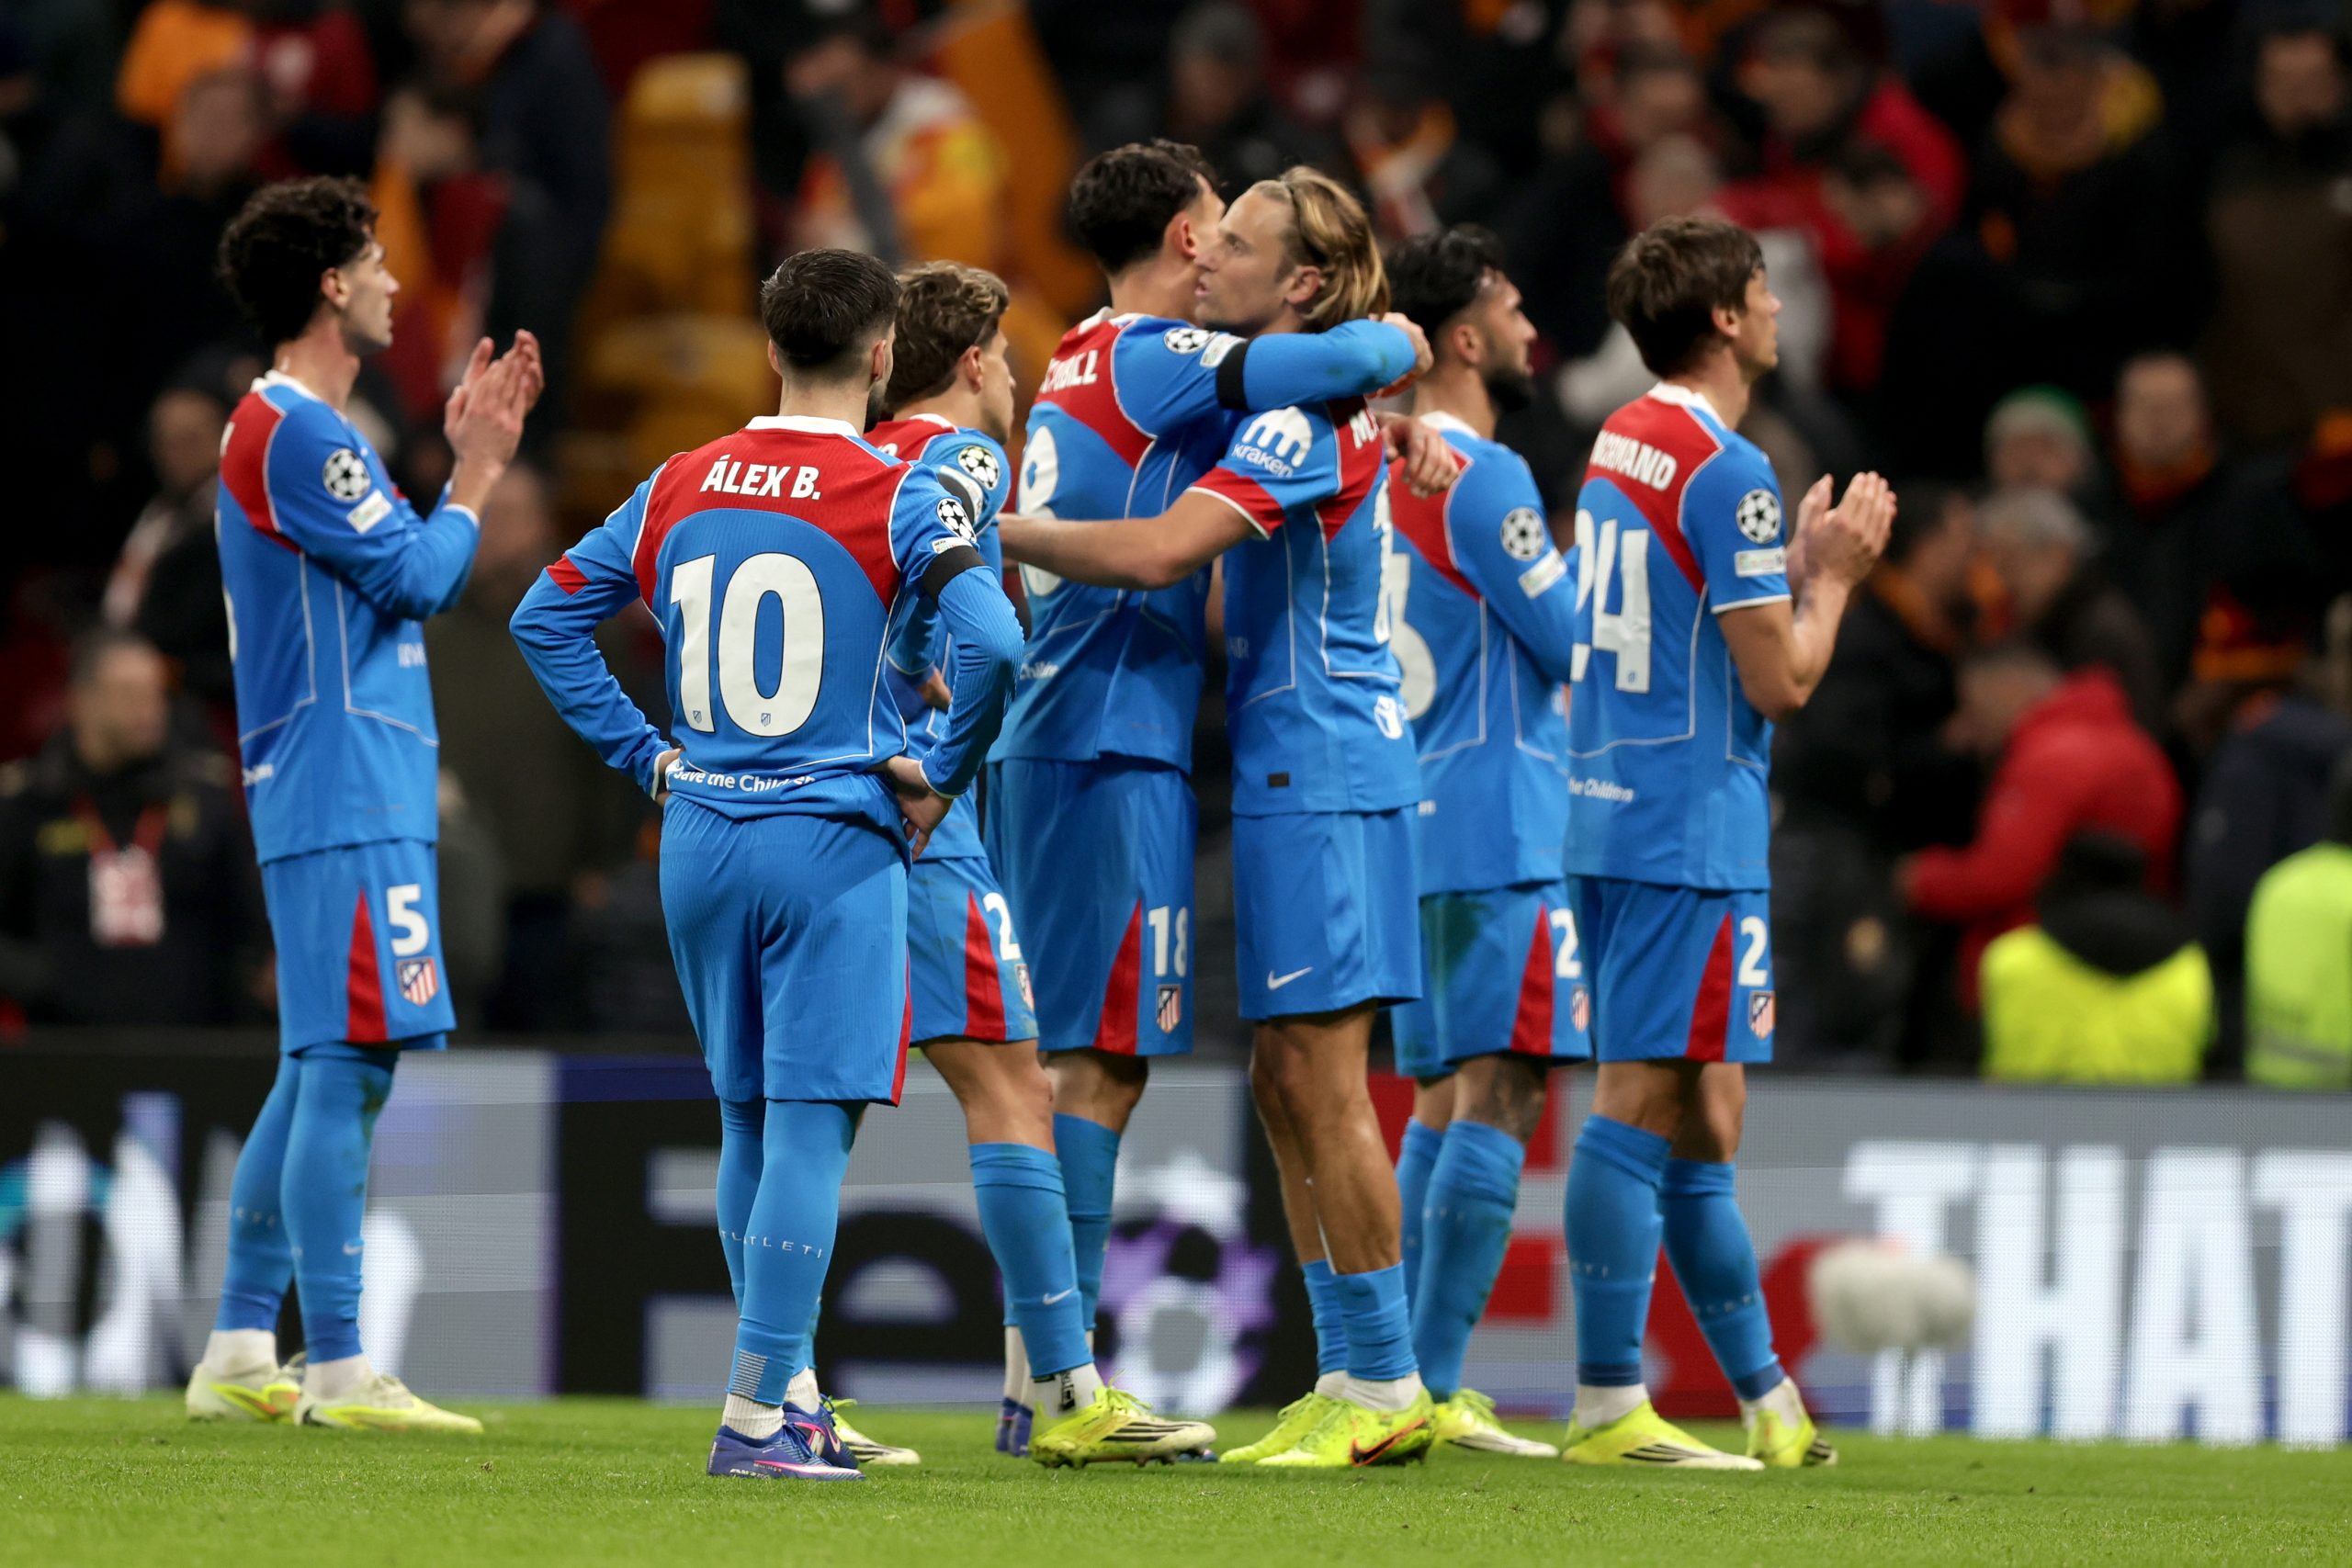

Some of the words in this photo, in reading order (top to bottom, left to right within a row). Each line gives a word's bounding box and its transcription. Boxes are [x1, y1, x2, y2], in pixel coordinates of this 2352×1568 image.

[700, 454, 790, 498] ÁLEX
[789, 466, 822, 501] B.
[1231, 444, 1294, 479] kraken
[670, 552, 825, 737] 10
[1567, 776, 1584, 795] he
[387, 883, 429, 956] 5
[983, 892, 1022, 961] 2
[1148, 905, 1188, 977] 18
[1550, 908, 1582, 978] 2
[1738, 915, 1769, 987] 2
[1843, 1139, 2352, 1448] THAT
